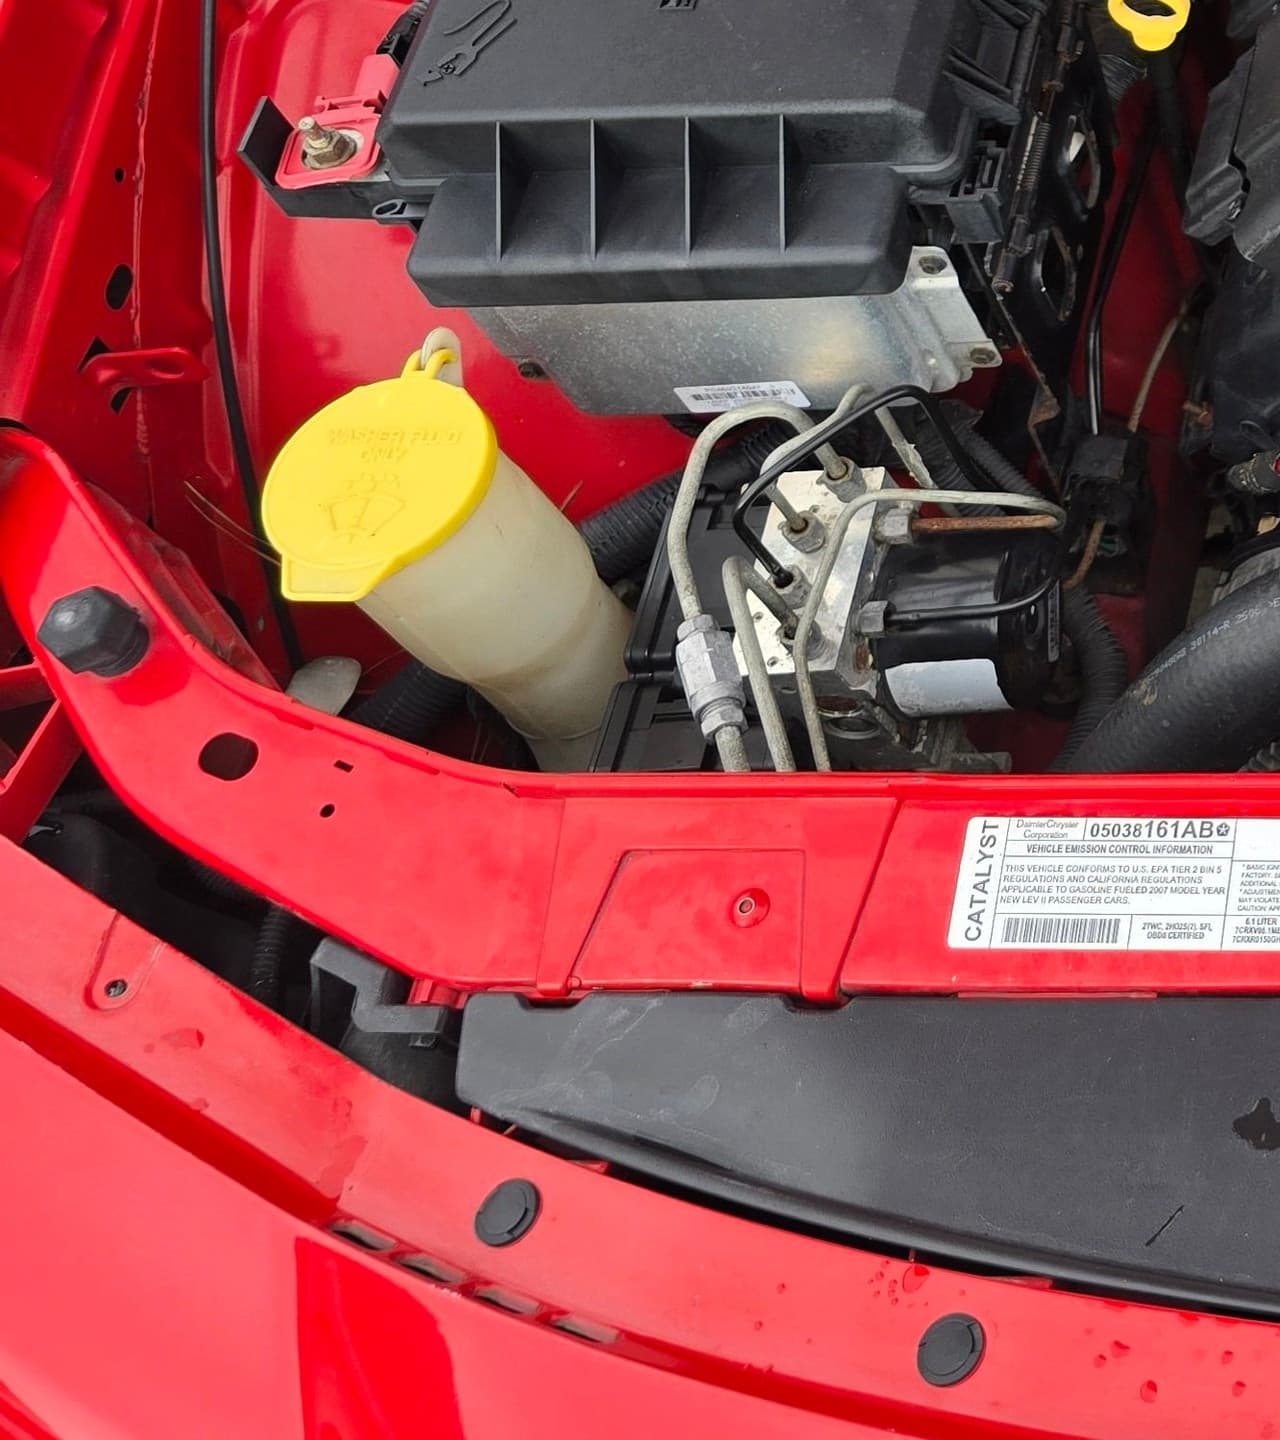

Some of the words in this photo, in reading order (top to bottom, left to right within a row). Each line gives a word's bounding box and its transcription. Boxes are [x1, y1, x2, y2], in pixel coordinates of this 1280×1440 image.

[1016, 819, 1078, 830] DaimlerChrysler
[1090, 821, 1214, 839] 05038161AB
[1024, 830, 1068, 840] Corporation
[1027, 843, 1062, 854] VEHICLE
[1064, 844, 1106, 854] EMISSION
[1108, 844, 1149, 855] CONTROL
[1152, 845, 1212, 855] INFORMATION
[1005, 864, 1024, 873] THIS
[1026, 864, 1063, 873] VEHICLE
[1065, 864, 1115, 874] CONFORMS
[1118, 865, 1130, 874] TO
[1150, 865, 1168, 874] EPA
[1171, 865, 1190, 874] TIER
[1192, 865, 1198, 875] 2
[1199, 865, 1214, 875] BIN
[1216, 866, 1222, 875] 5
[964, 819, 1000, 942] CATALYST
[1003, 874, 1064, 884] REGULATIONS
[1066, 875, 1085, 884] AND
[1087, 875, 1138, 885] CALIFORNIA
[1140, 875, 1203, 885] REGULATIONS
[1001, 885, 1052, 894] APPLICABLE
[1056, 885, 1067, 894] TO
[1068, 885, 1112, 895] GASOLINE
[1113, 885, 1147, 895] FUELED
[1148, 886, 1168, 895] 2007
[1169, 886, 1198, 896] MODEL
[1202, 886, 1225, 896] YEAR
[1000, 895, 1020, 905] NEW
[1021, 895, 1039, 905] LEV
[1040, 895, 1046, 905] II
[1047, 895, 1101, 905] PASSENGER
[1103, 896, 1130, 905] CARS.
